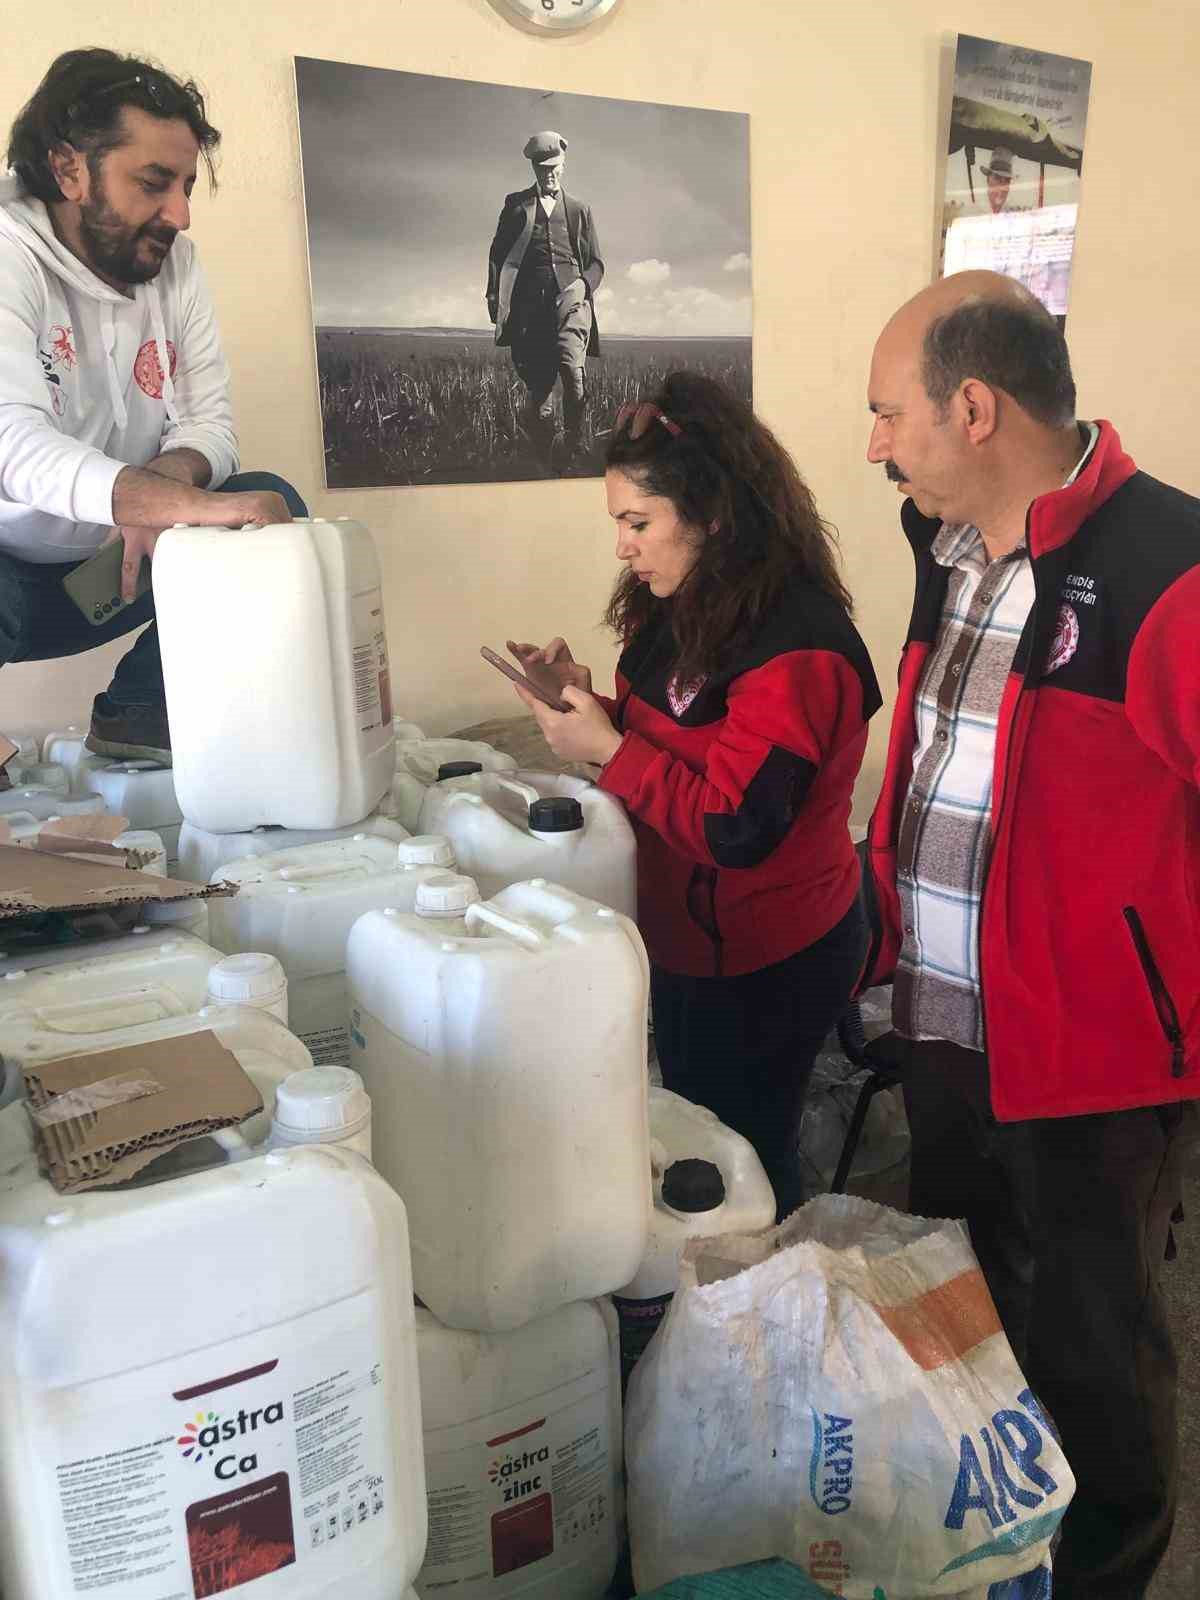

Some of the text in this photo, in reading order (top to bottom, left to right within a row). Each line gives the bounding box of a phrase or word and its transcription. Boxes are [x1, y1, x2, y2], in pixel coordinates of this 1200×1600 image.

[199, 1402, 283, 1447] astra
[214, 1453, 257, 1479] Ca
[500, 1446, 549, 1477] astra
[823, 1413, 853, 1515] AKPRO
[944, 1388, 1062, 1529] AKP
[503, 1475, 542, 1502] zinc
